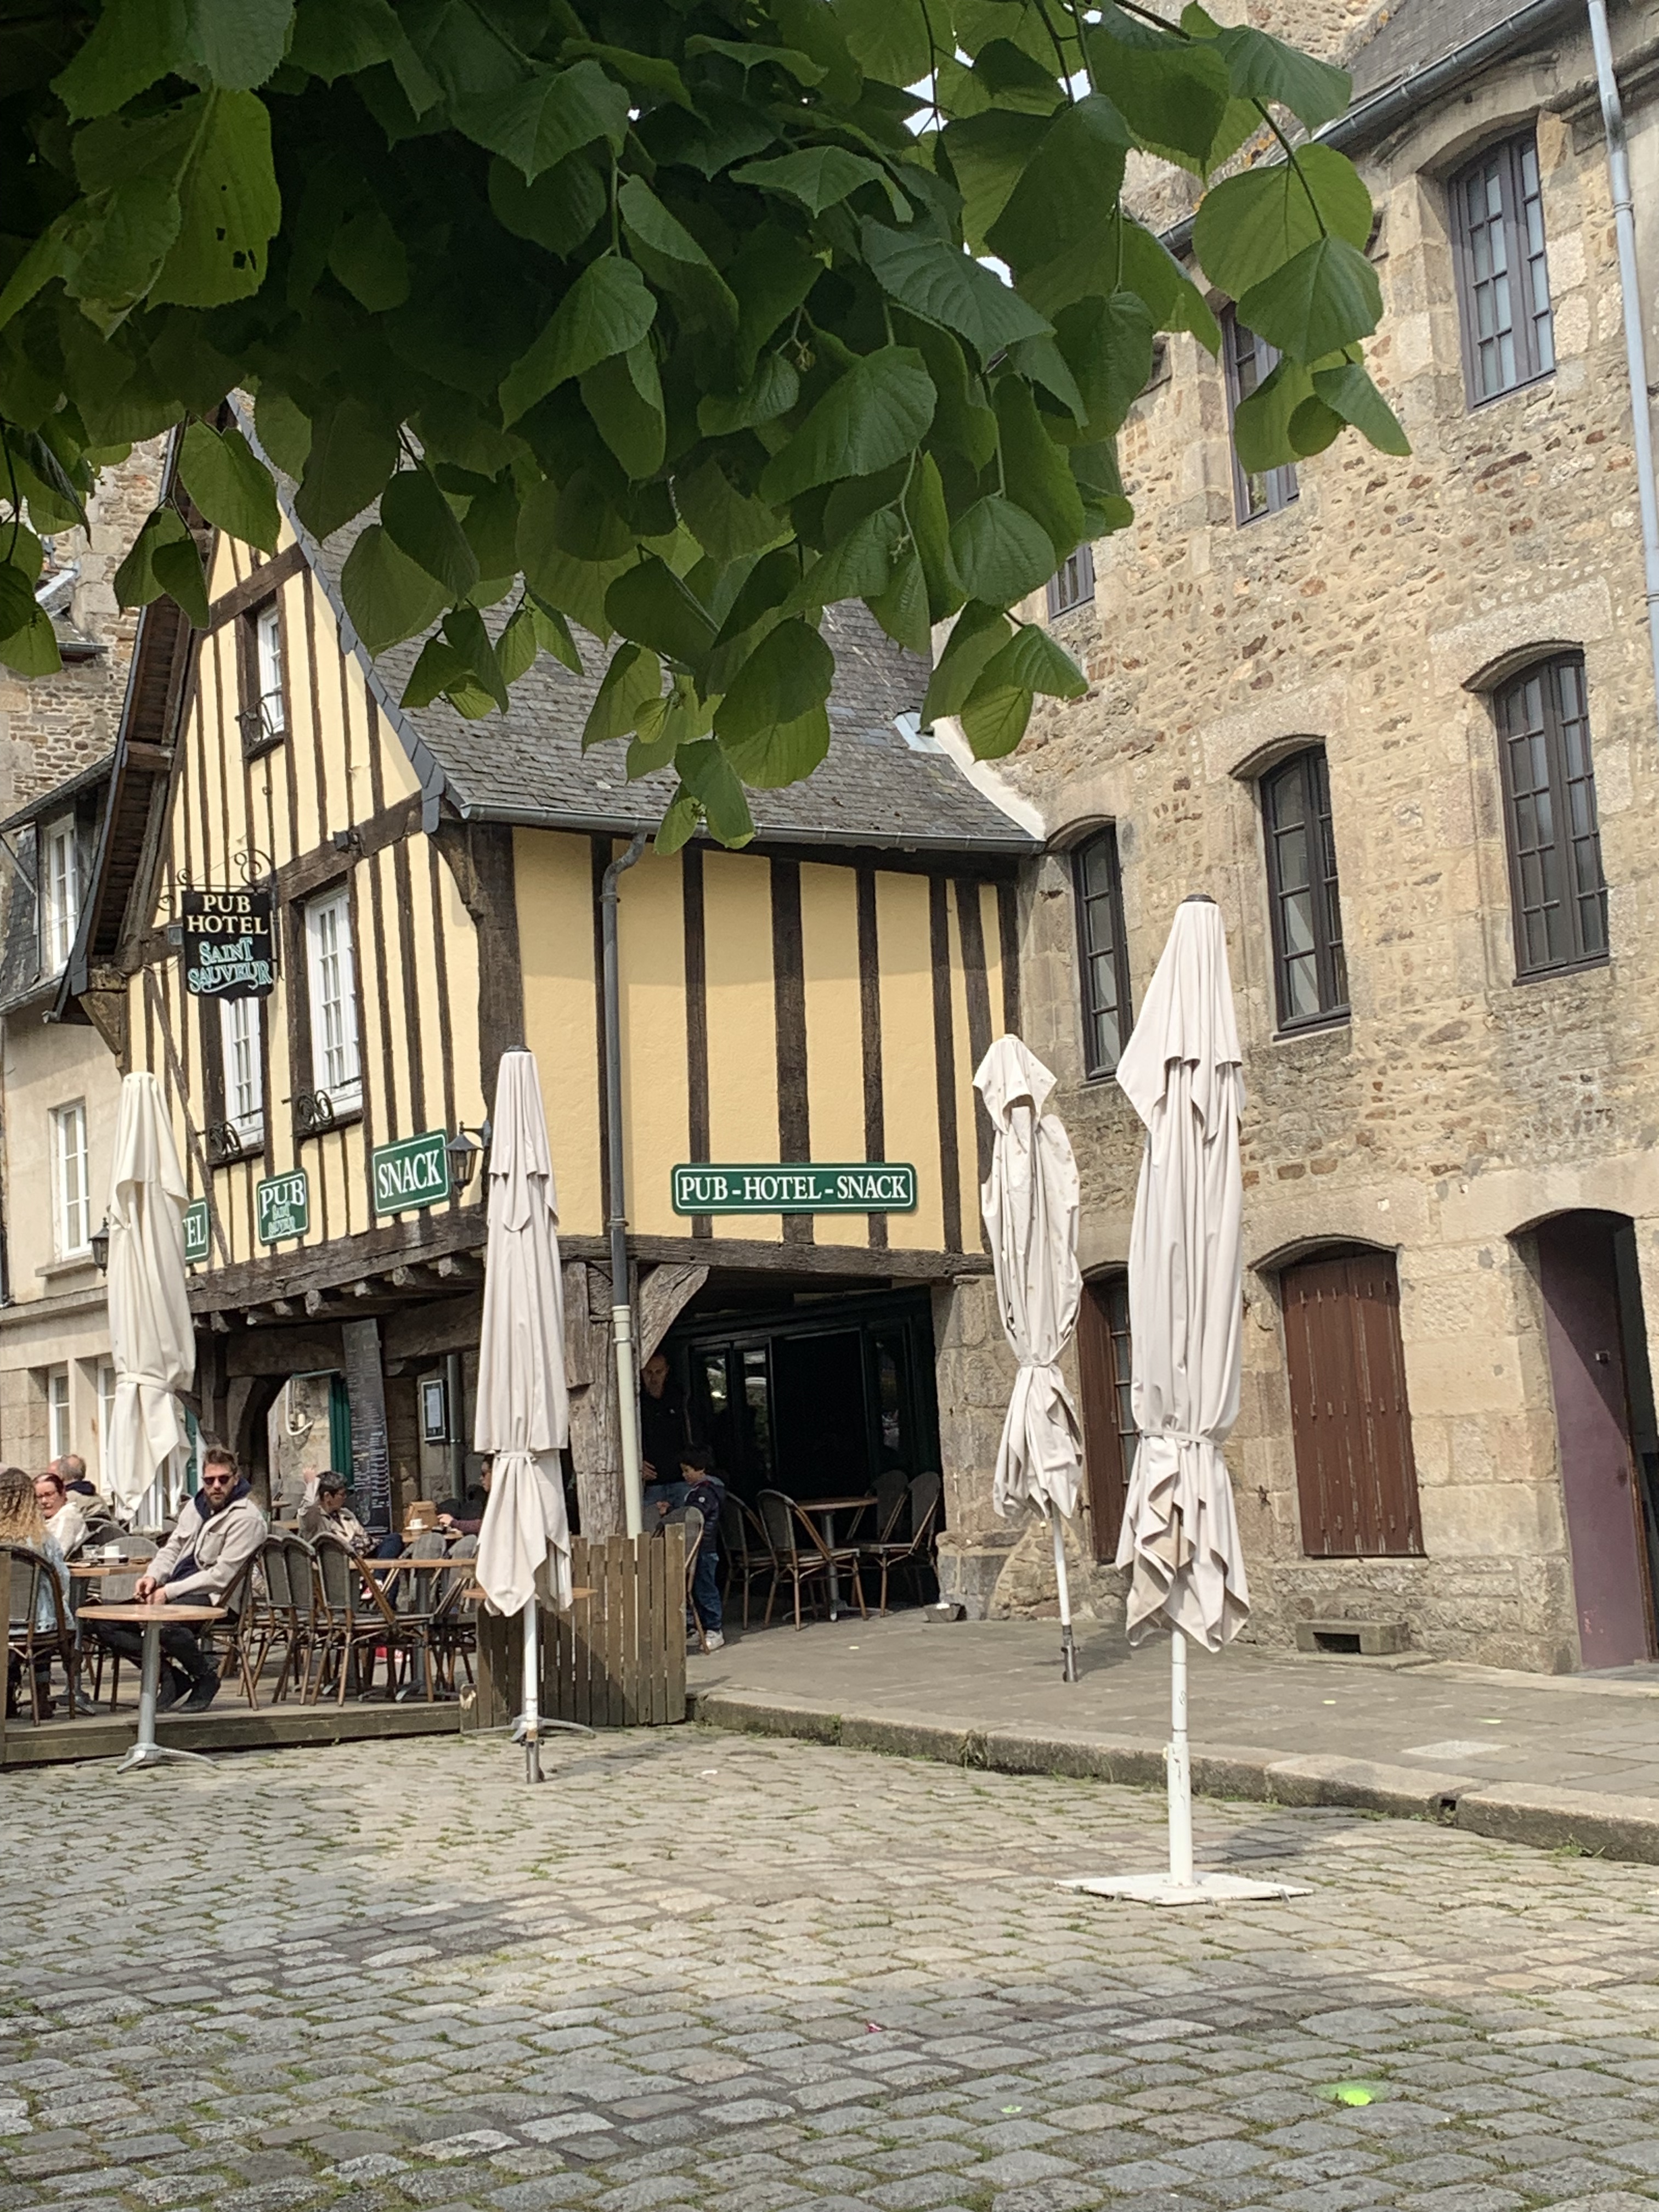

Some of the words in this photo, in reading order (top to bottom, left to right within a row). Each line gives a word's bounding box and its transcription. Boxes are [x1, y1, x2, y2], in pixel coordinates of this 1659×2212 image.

[203, 894, 251, 913] PUB
[187, 915, 269, 934] HOTEL
[199, 936, 253, 966] SAINT
[188, 960, 273, 993] SAUVEUR
[378, 1149, 443, 1199] SNACK
[260, 1179, 304, 1219] PUB
